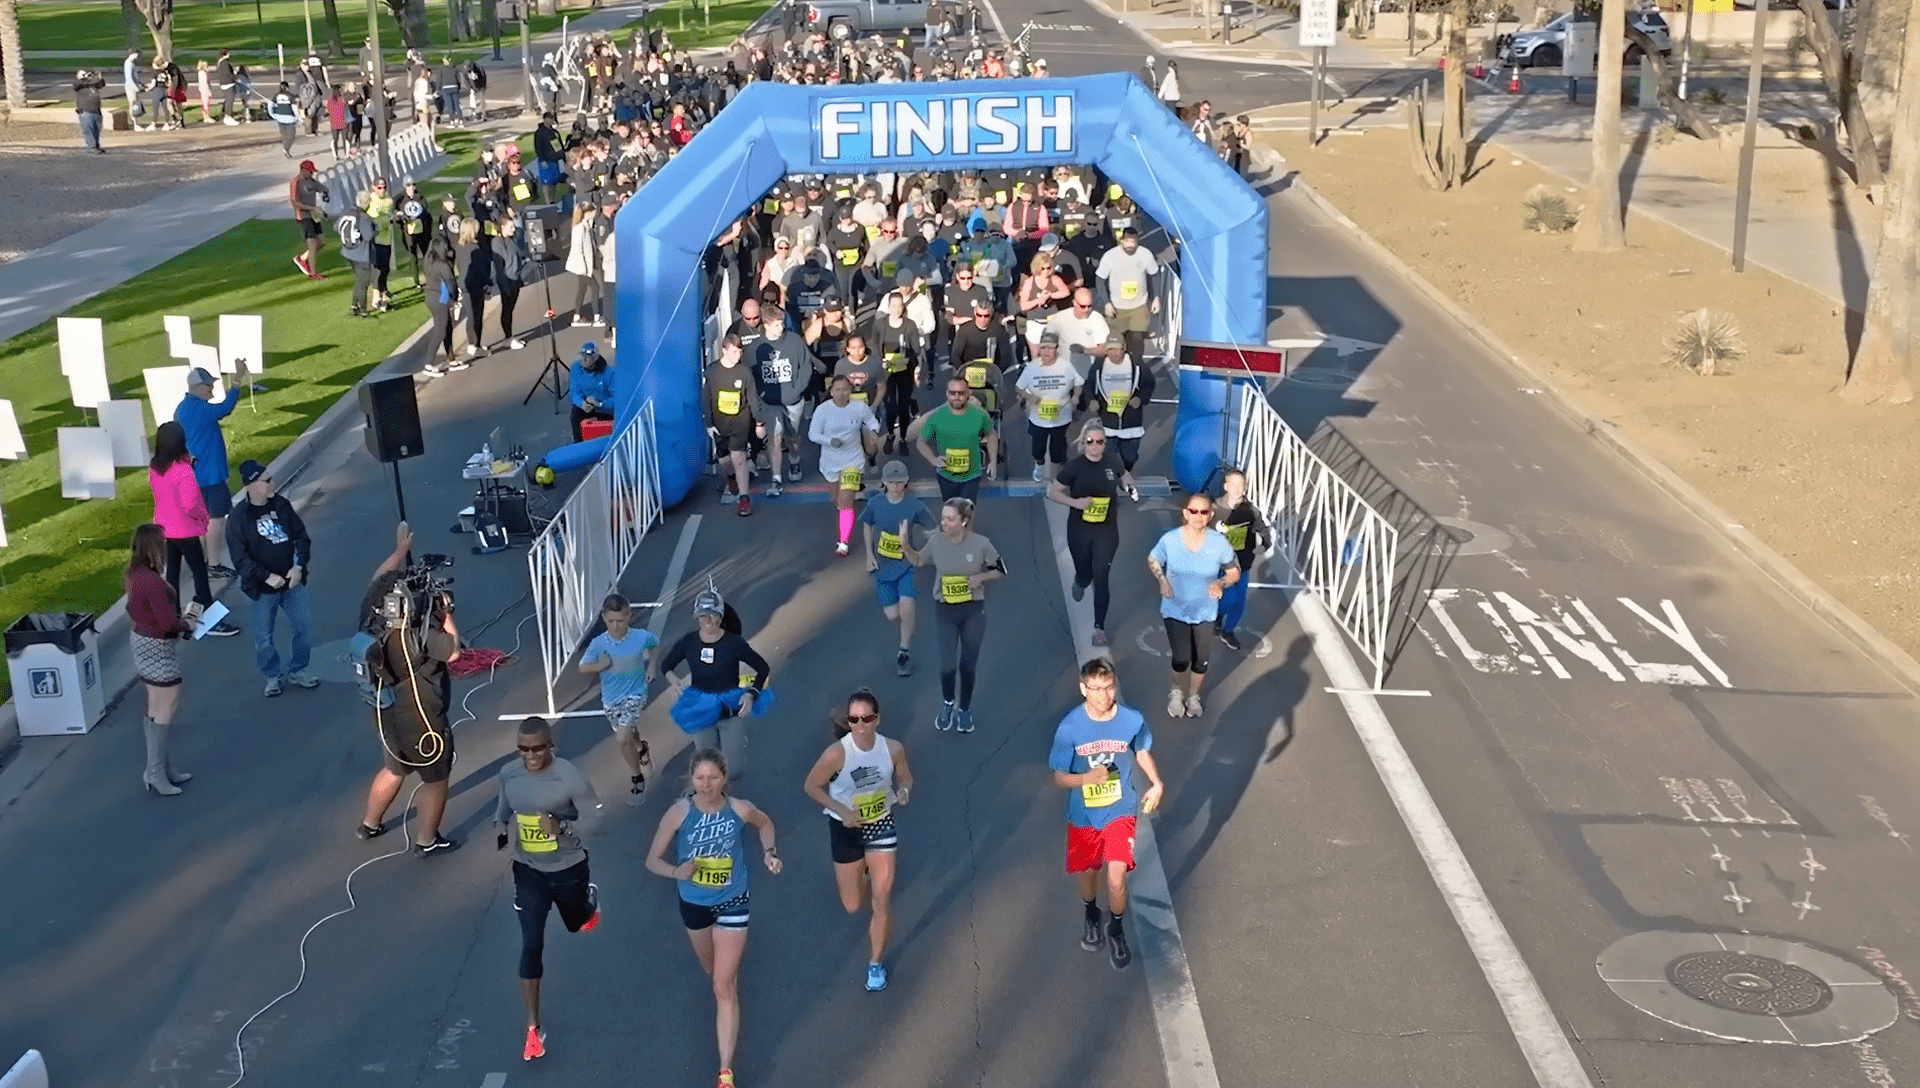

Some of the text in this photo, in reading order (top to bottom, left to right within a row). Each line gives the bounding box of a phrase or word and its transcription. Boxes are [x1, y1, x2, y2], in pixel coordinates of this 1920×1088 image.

[820, 96, 1073, 160] FINISH
[1424, 588, 1733, 689] ONLY
[698, 819, 735, 842] LIFE
[698, 869, 729, 884] 1195
